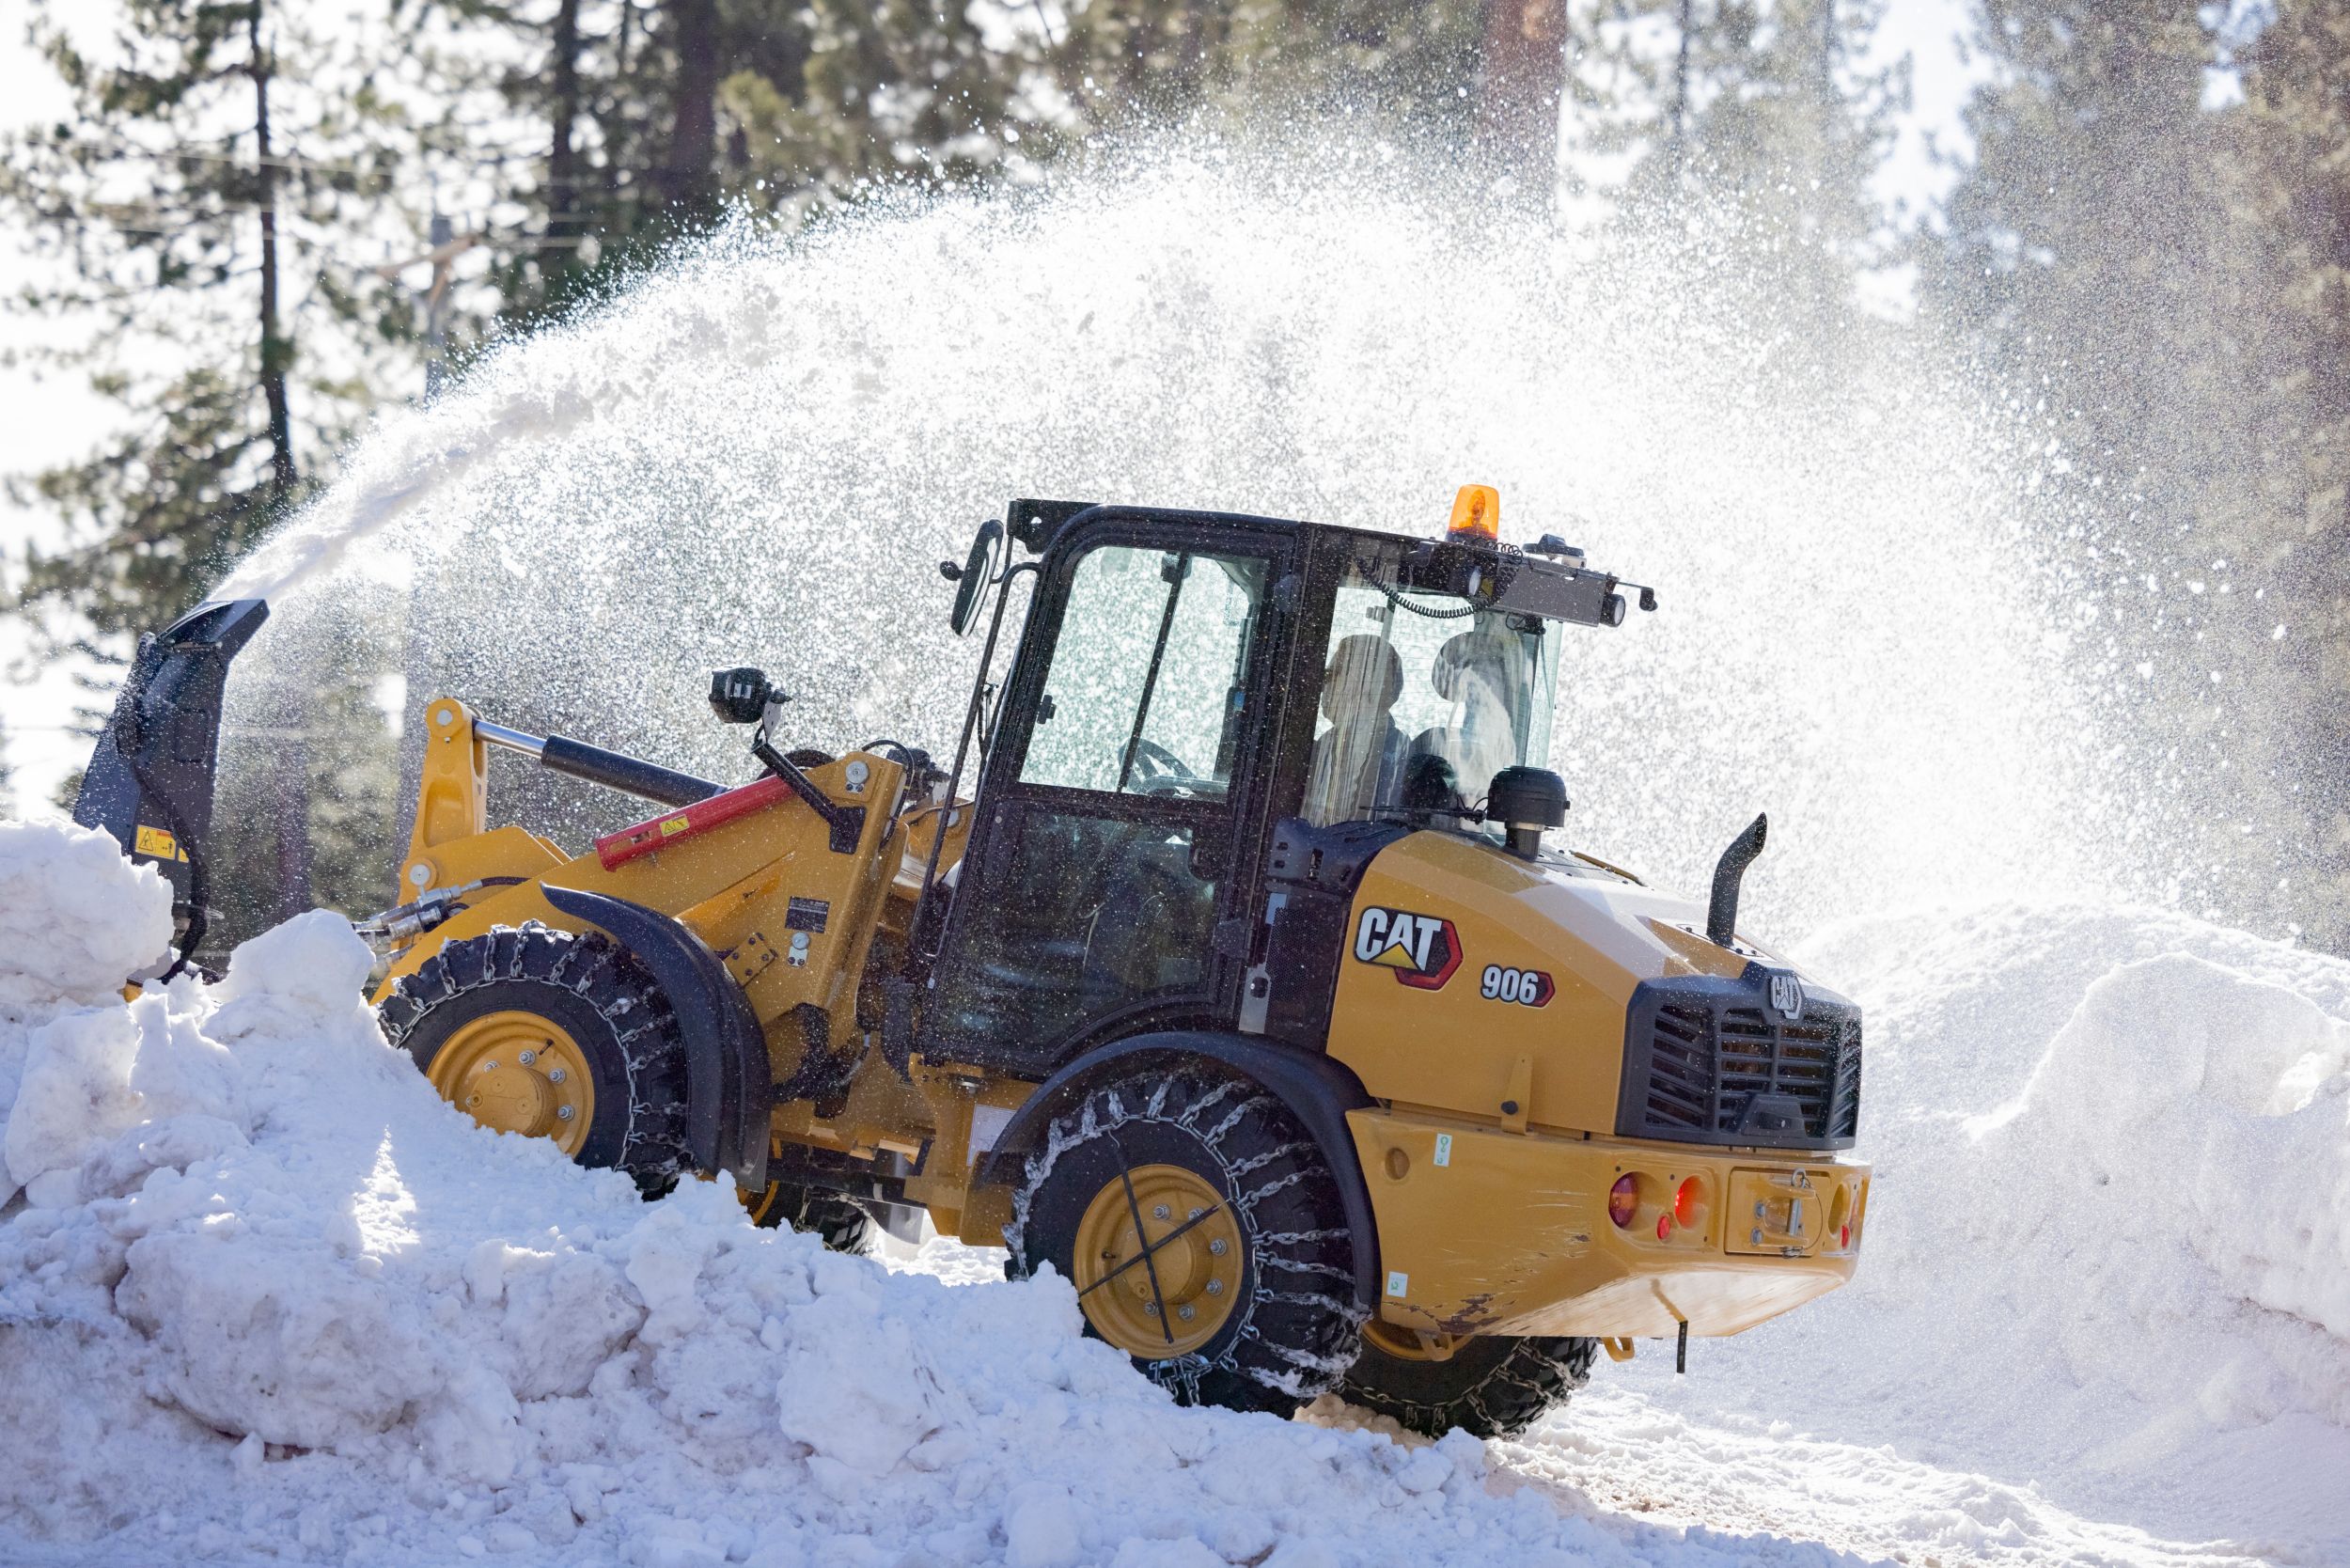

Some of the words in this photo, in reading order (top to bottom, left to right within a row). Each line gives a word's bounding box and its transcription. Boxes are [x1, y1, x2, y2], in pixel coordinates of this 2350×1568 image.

[1355, 907, 1443, 971] CAT
[1482, 965, 1539, 1004] 906
[1771, 976, 1796, 1011] CAT
